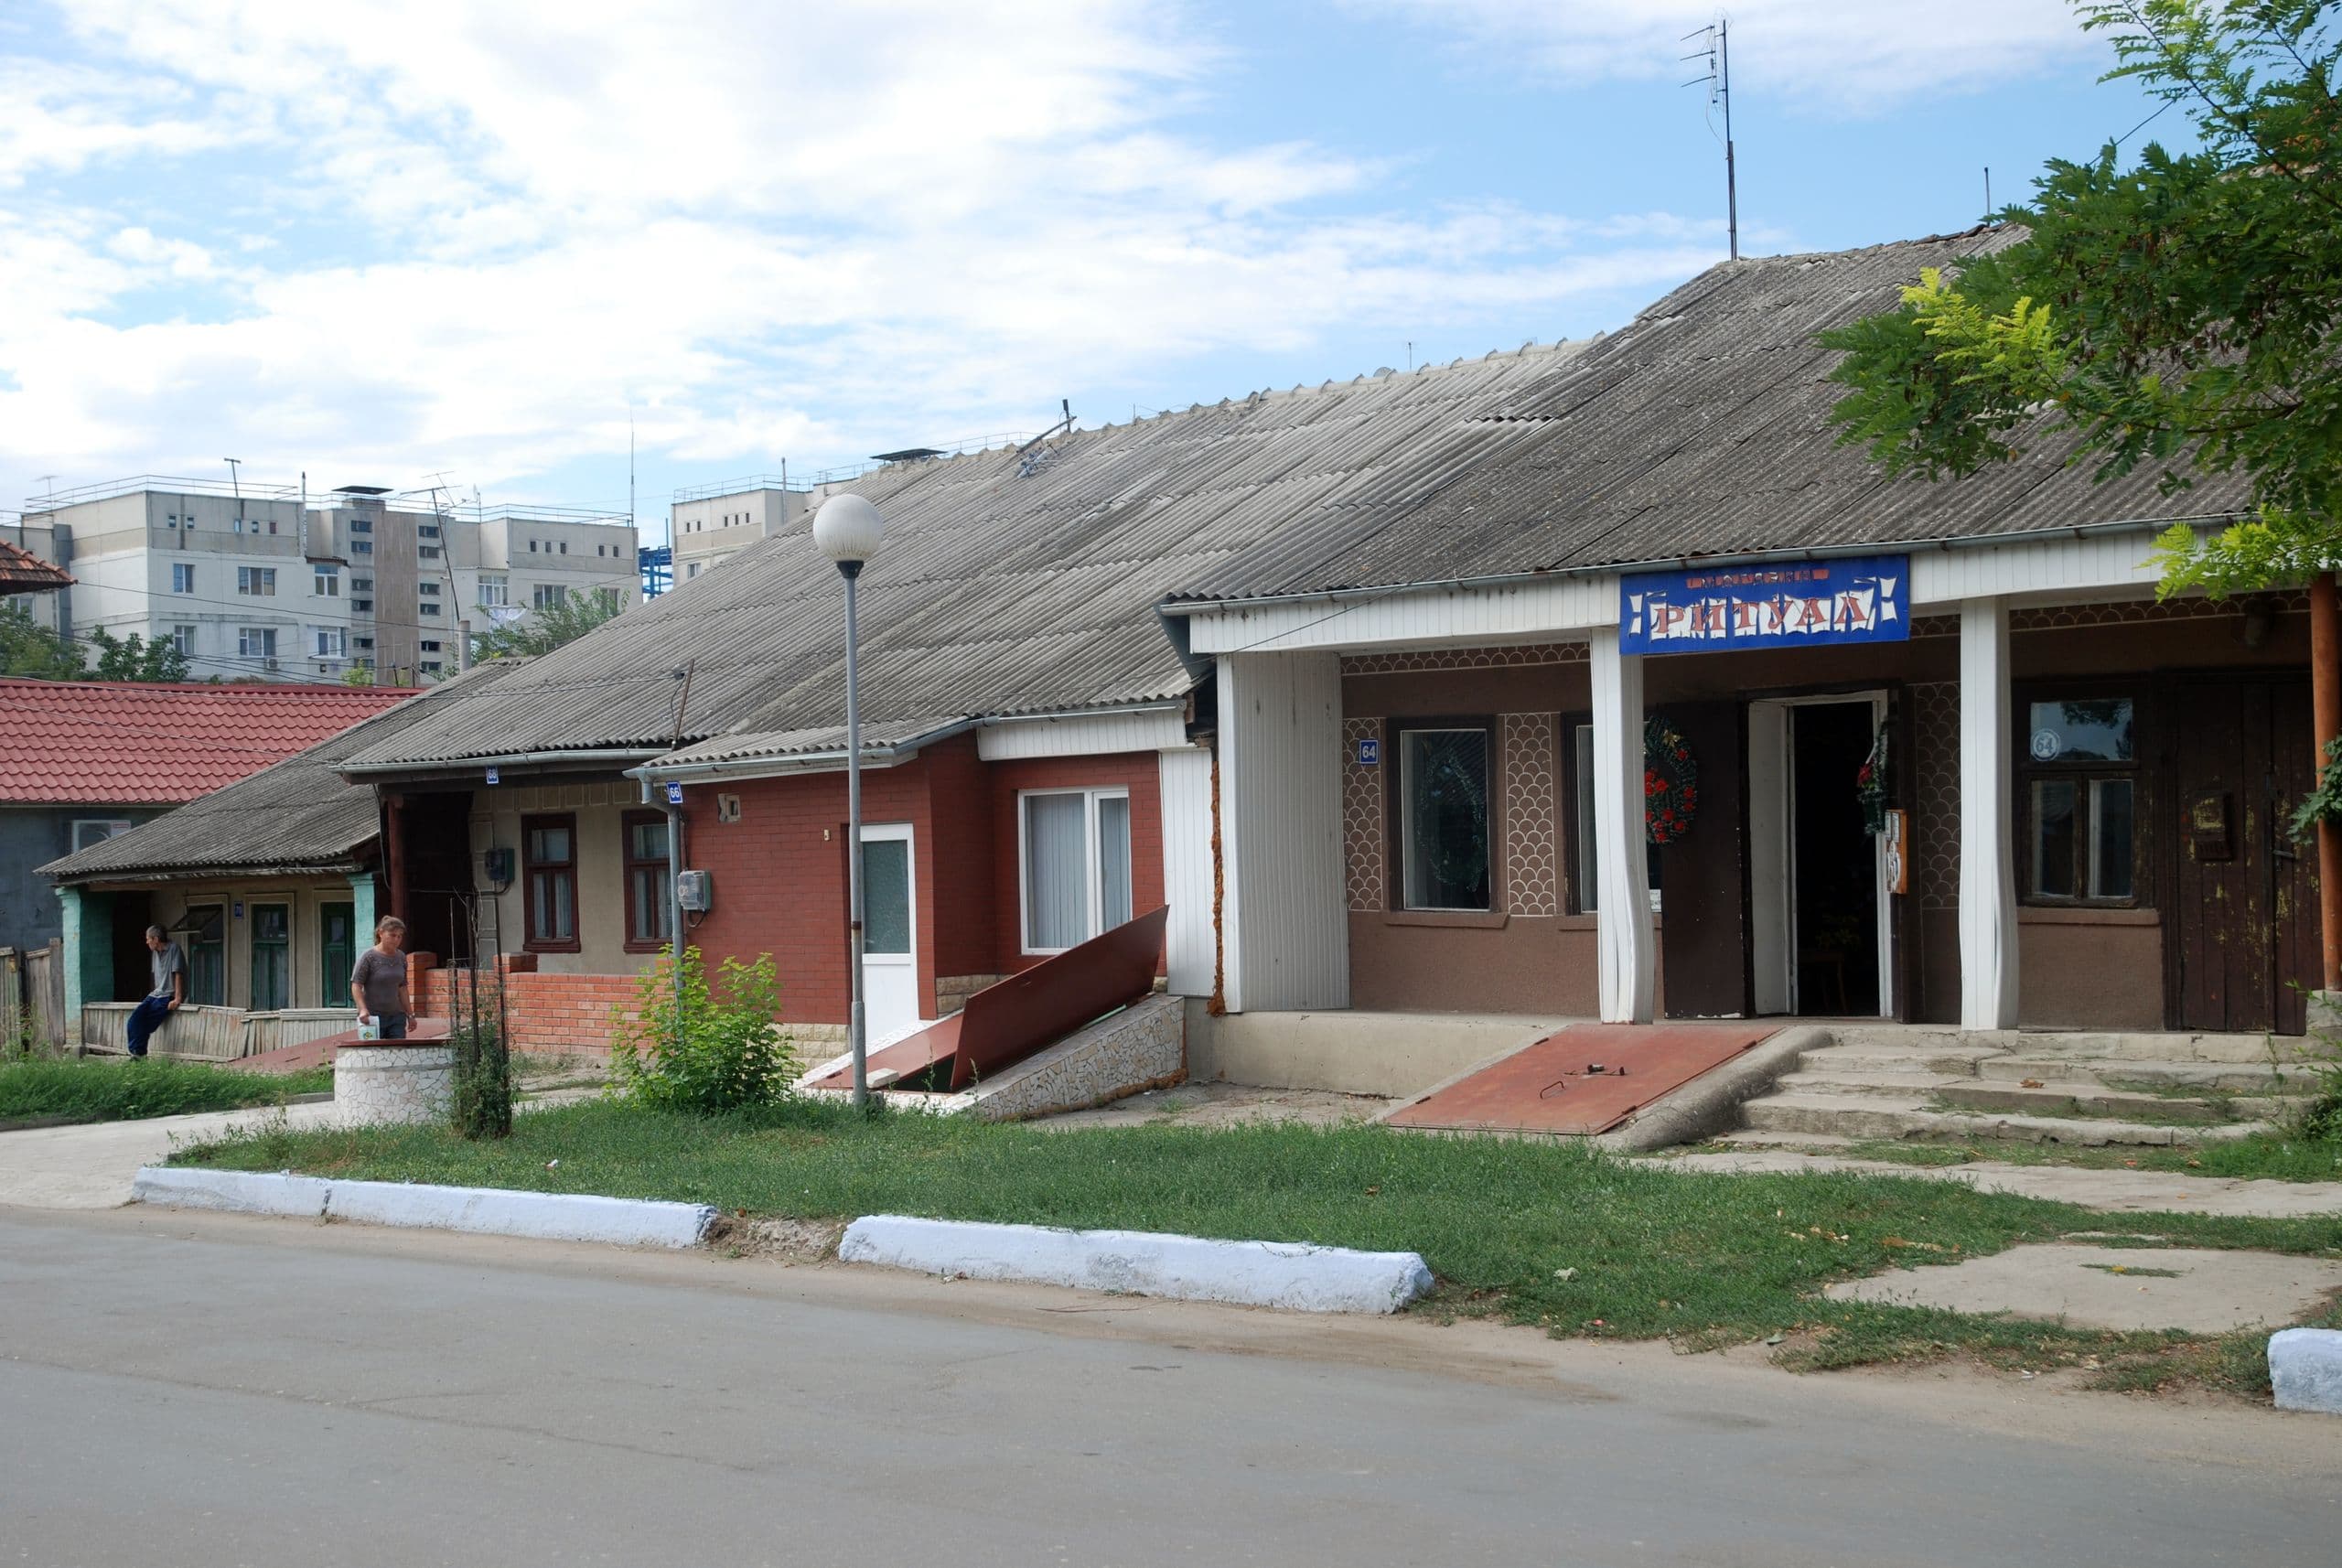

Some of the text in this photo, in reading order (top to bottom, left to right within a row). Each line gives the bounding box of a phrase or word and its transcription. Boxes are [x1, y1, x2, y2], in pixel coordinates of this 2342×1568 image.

[1652, 596, 1869, 634] РИТУАЛ
[1362, 745, 1376, 758] 64
[2036, 736, 2054, 754] 64
[488, 768, 497, 779] 68
[670, 787, 680, 798] 66
